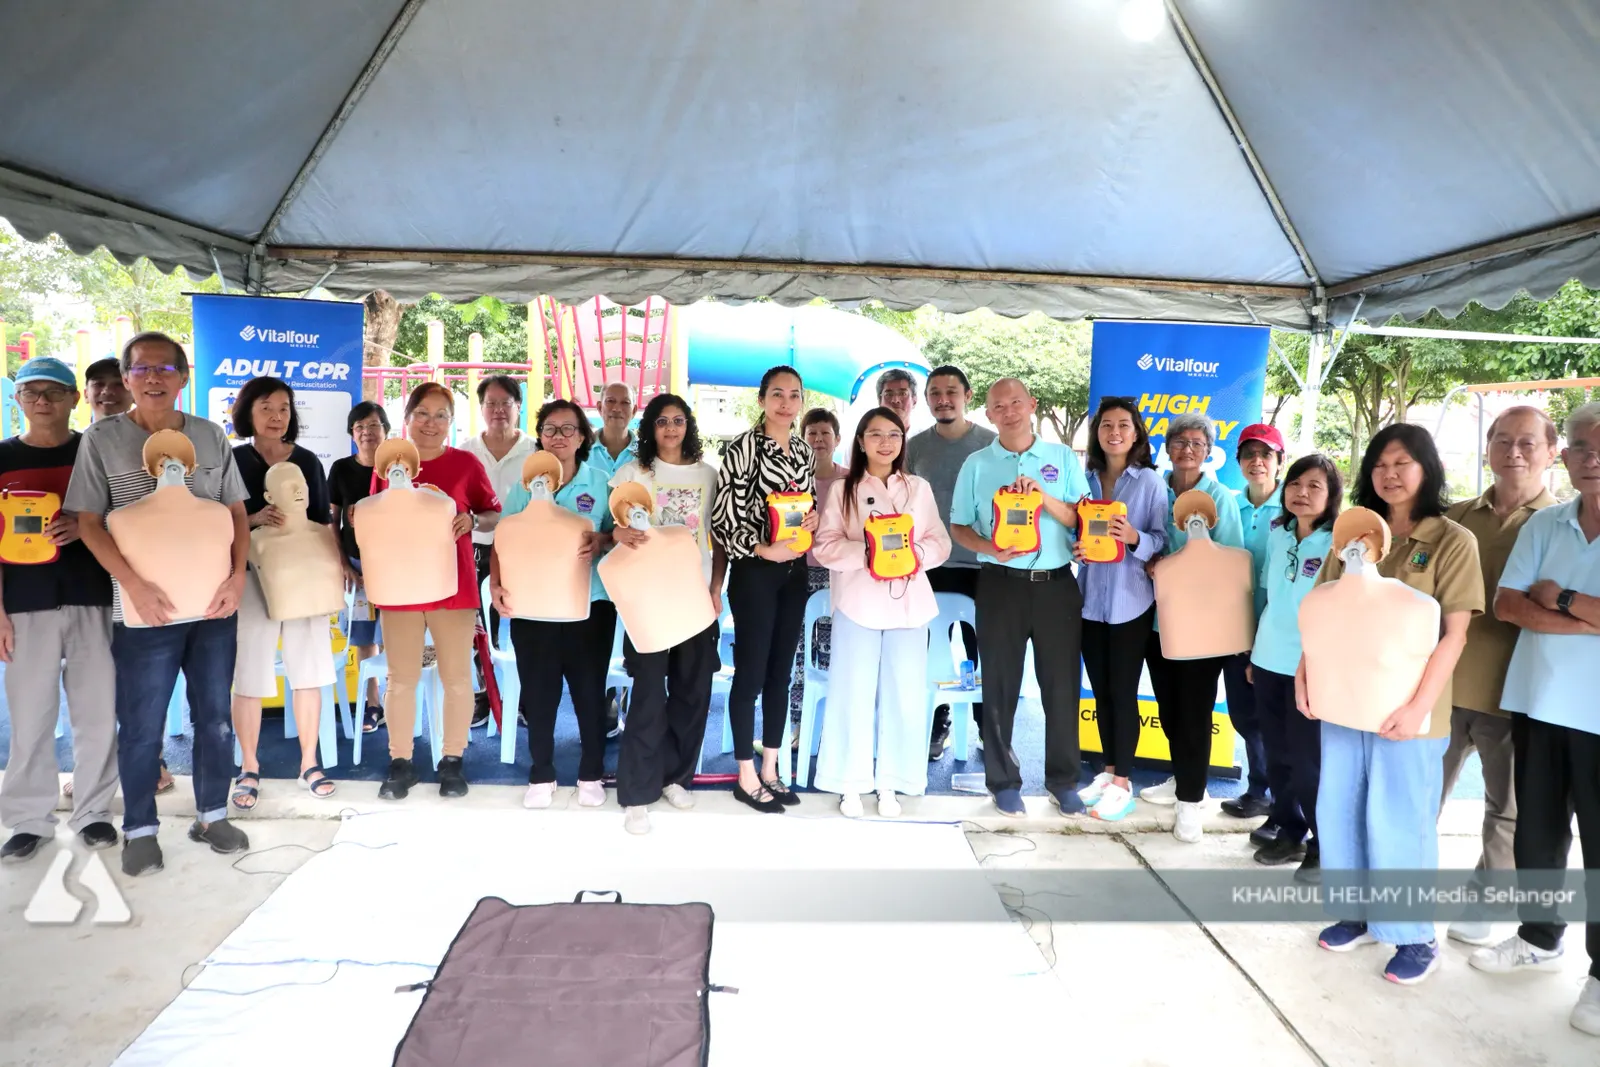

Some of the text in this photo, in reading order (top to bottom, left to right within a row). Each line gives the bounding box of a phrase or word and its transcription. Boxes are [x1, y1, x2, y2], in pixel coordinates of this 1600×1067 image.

[256, 328, 320, 344] Vitalfour
[213, 358, 350, 380] ADULT CPR
[1154, 357, 1220, 374] Vitalfour
[291, 380, 337, 389] Resuscitation
[1137, 393, 1211, 415] HIGH
